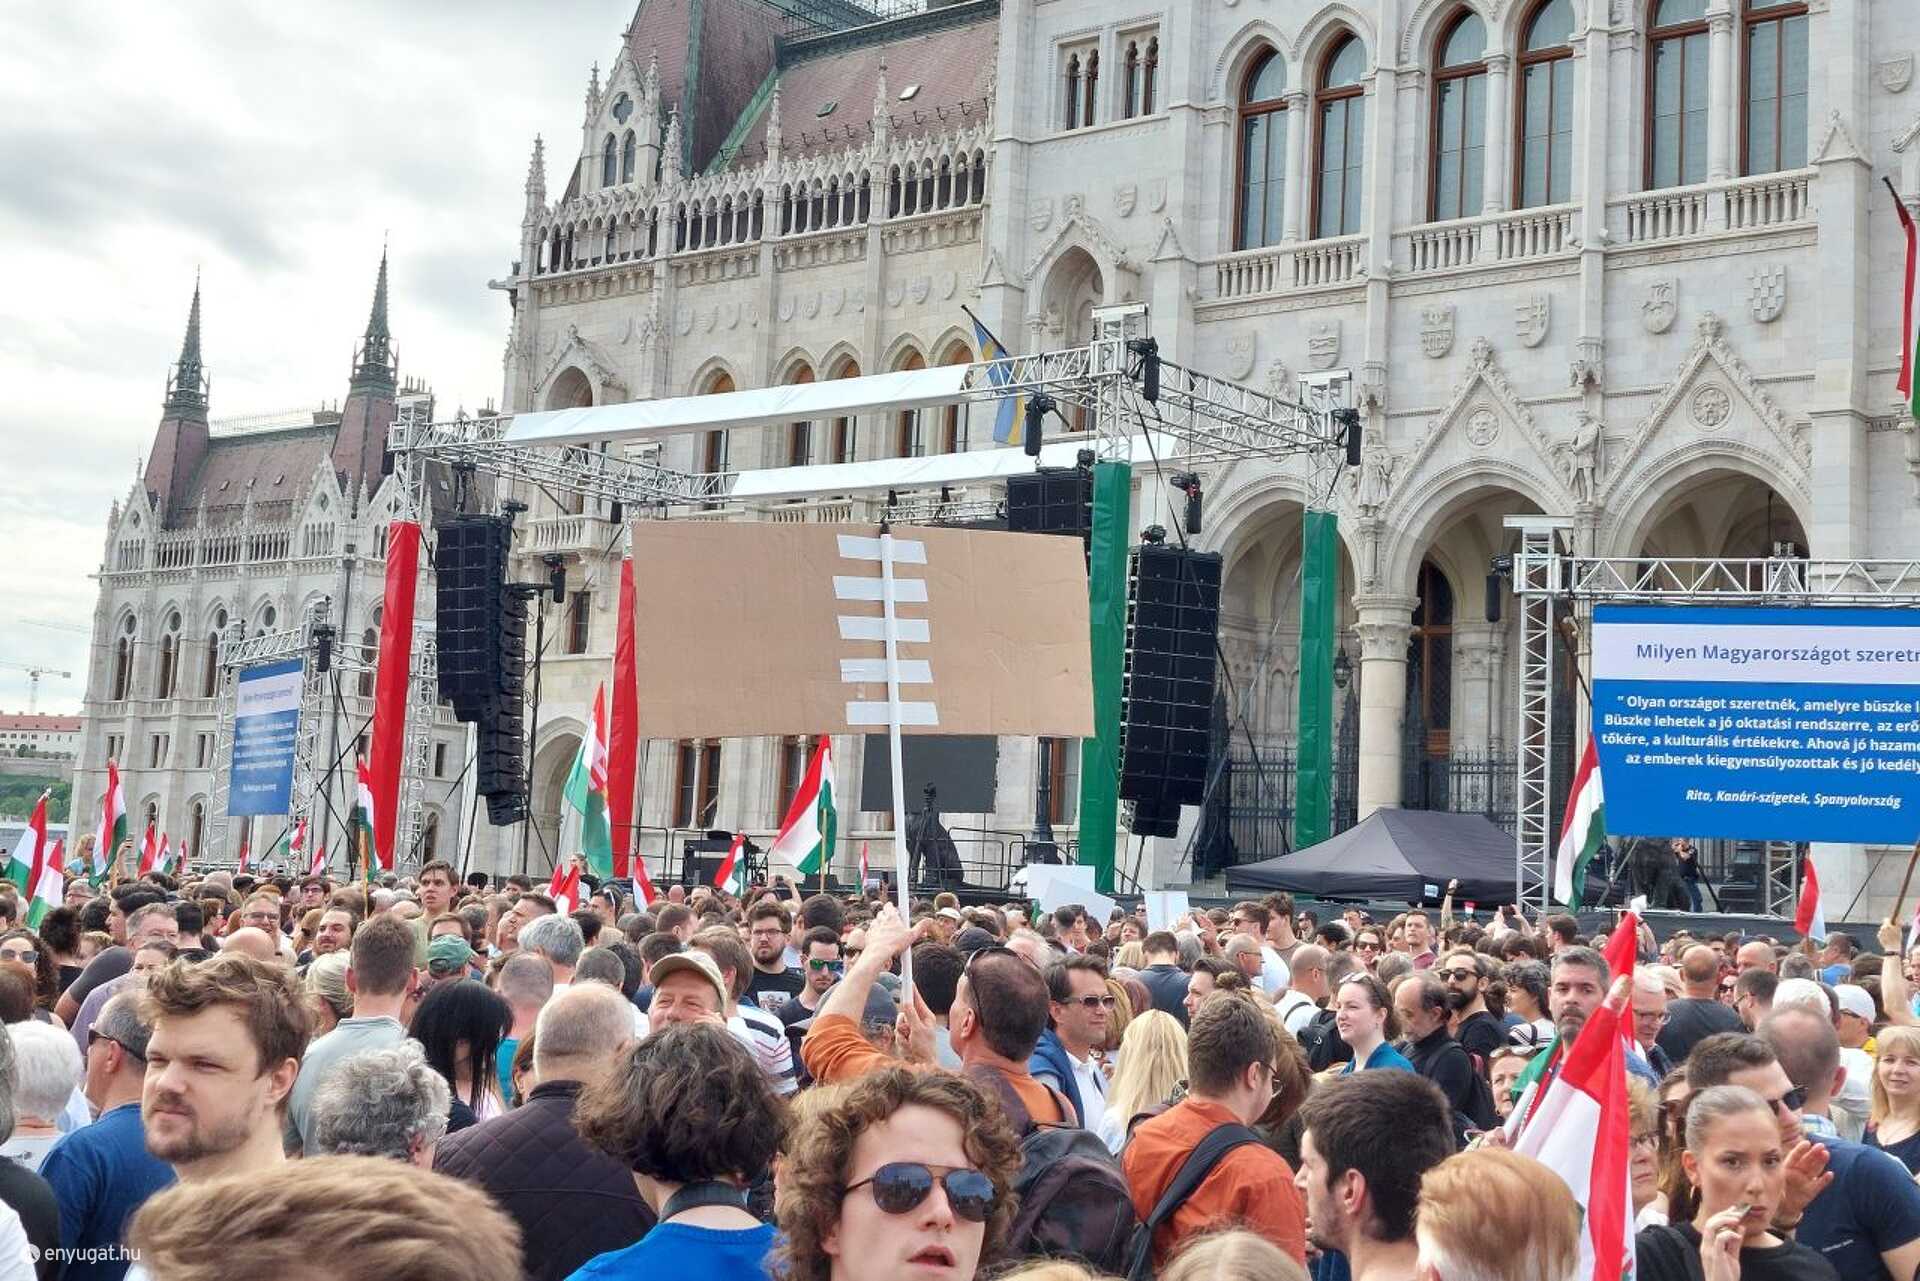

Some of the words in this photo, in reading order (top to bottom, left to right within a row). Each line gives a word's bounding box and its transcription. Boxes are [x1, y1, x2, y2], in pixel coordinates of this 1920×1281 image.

[1637, 644, 1696, 662] Milyen
[1703, 645, 1851, 665] Magyarországot
[1627, 696, 1666, 710] Olyan
[1669, 697, 1727, 711] országot
[1729, 698, 1800, 712] szeretnék,
[1804, 700, 1860, 714] amelyre
[1655, 715, 1705, 728] lehetek
[1709, 719, 1716, 728] a
[1718, 716, 1732, 731] jó
[1736, 717, 1792, 730] oktatási
[1795, 719, 1873, 732] rendszerre,
[1877, 722, 1892, 732] az
[1652, 736, 1660, 745] a
[1664, 733, 1729, 746] kulturális
[1732, 735, 1803, 749] értékekre.
[1807, 738, 1850, 750] Ahová
[1852, 738, 1867, 753] jó
[1625, 754, 1641, 764] az
[1644, 753, 1703, 765] emberek
[1707, 754, 1839, 770] kiegyensúlyozottak
[1843, 758, 1858, 769] és
[1859, 758, 1874, 773] jó
